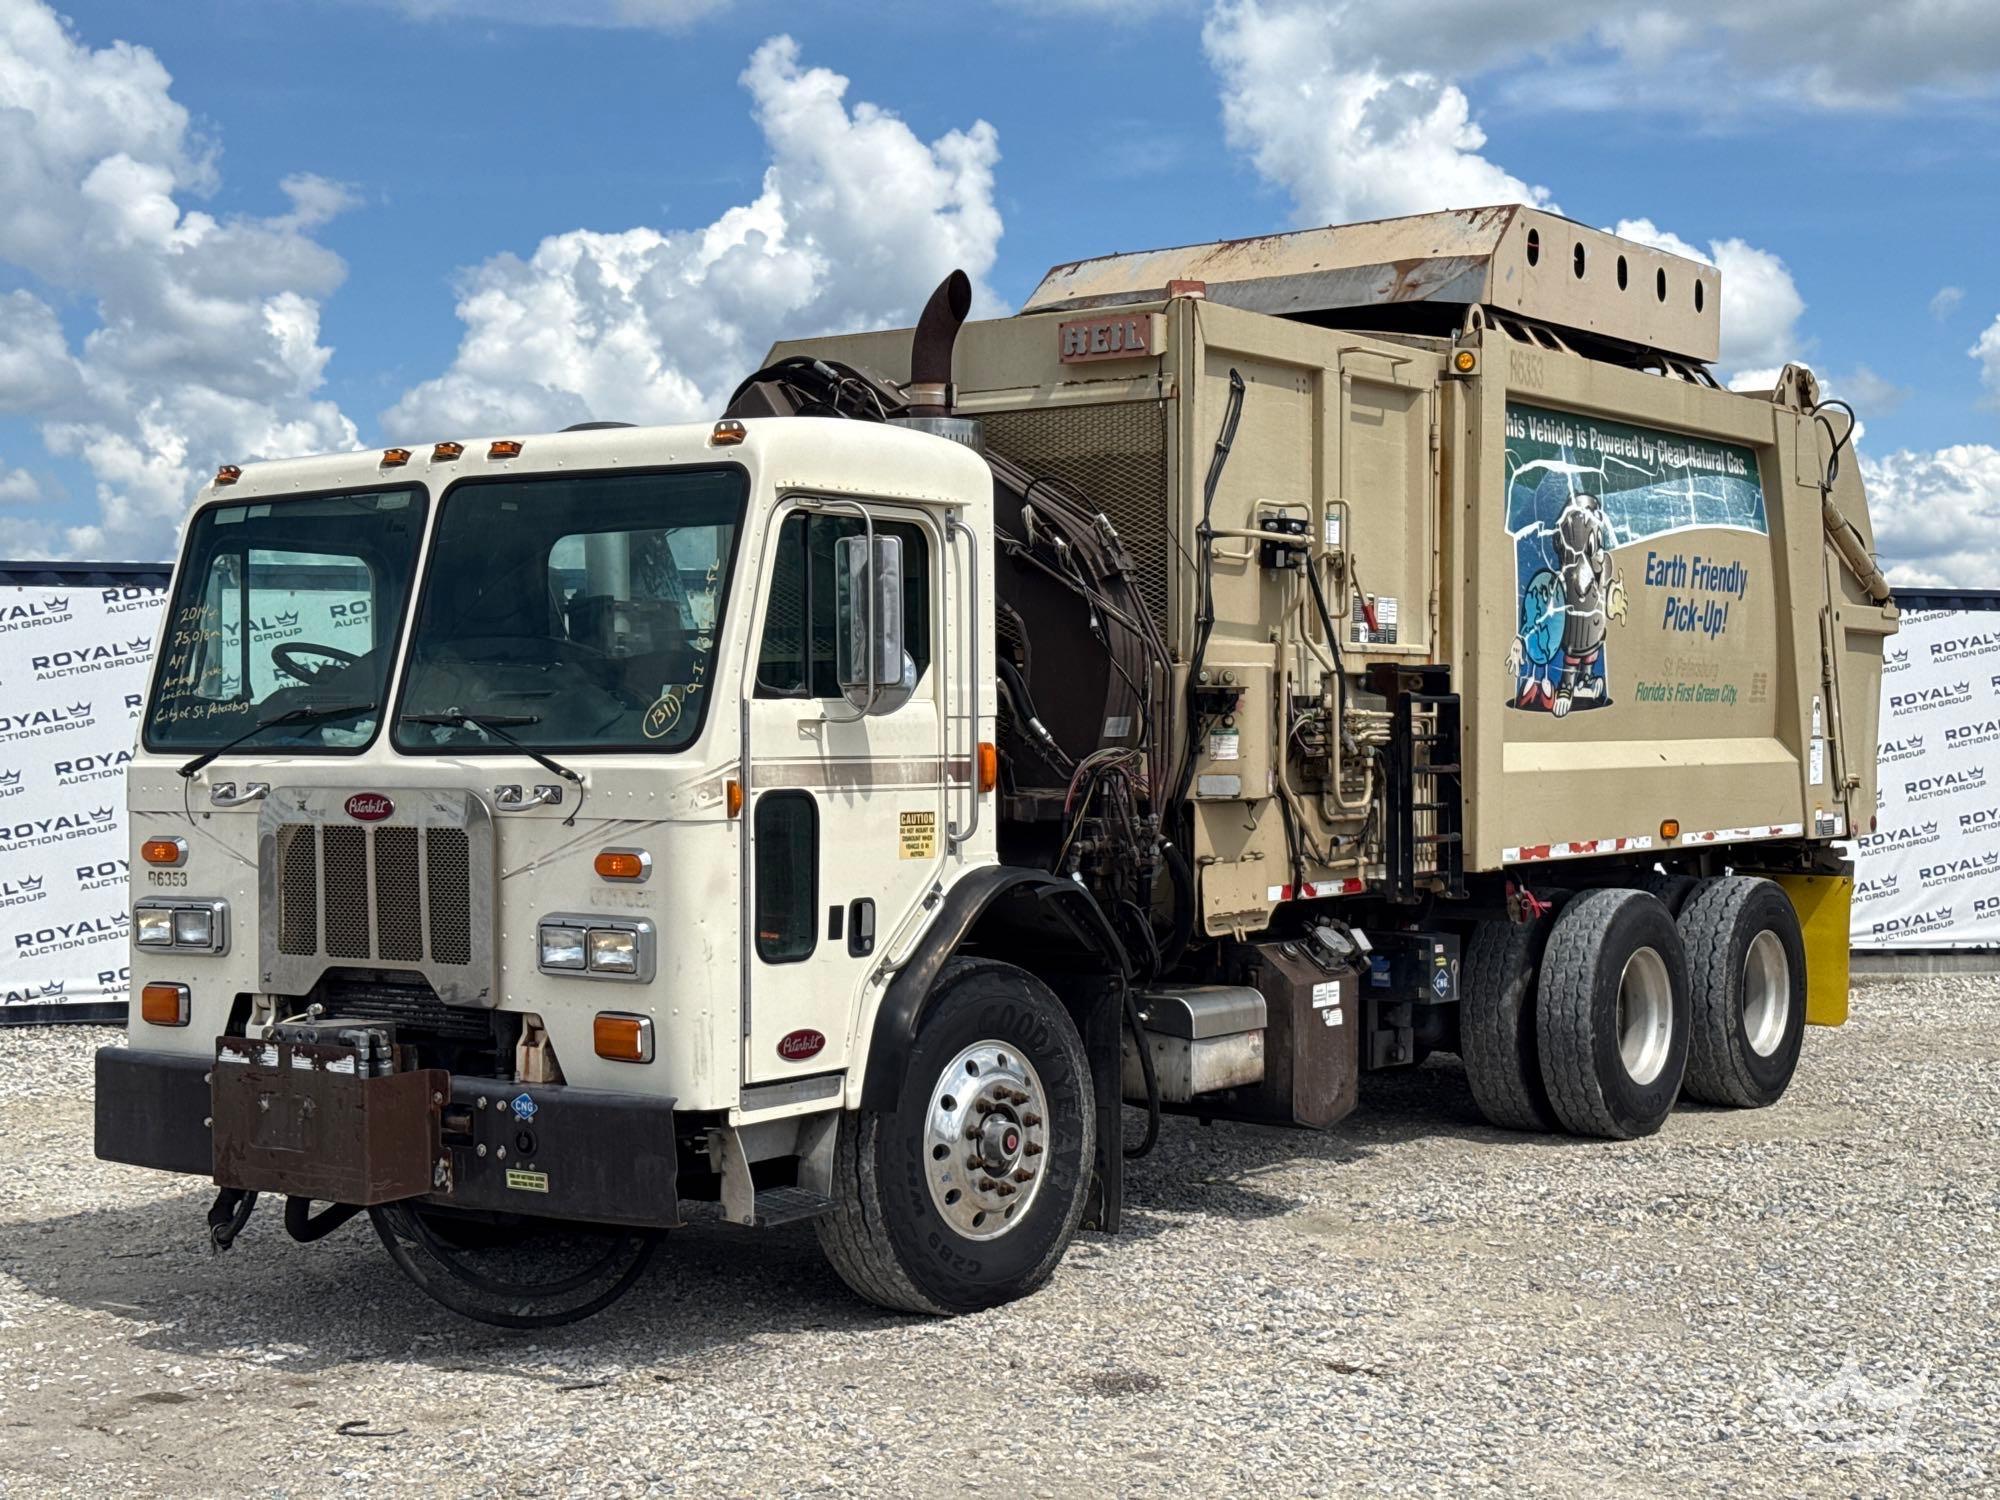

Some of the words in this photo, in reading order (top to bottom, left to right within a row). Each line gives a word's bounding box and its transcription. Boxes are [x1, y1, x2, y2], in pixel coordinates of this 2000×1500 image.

[1063, 321, 1145, 356] HEIL
[1506, 412, 1526, 440] his
[1528, 416, 1574, 448] Vehicle
[1576, 424, 1587, 450] is
[1590, 427, 1639, 459] Powered
[1641, 437, 1654, 466] by
[1657, 439, 1686, 466] Clean
[1688, 445, 1725, 472] Natural
[1726, 453, 1748, 475] Gas.
[1645, 551, 1687, 589] Earth
[1690, 556, 1748, 601] Friendly
[102, 587, 168, 604] ROY
[0, 603, 45, 622] YAL
[21, 613, 73, 629] GROUP
[334, 615, 371, 628] AUCT
[1662, 596, 1729, 640] Pick-Up!
[1899, 616, 1922, 626] TION
[1923, 609, 1958, 622] GROUP
[223, 617, 276, 636] YAL
[253, 627, 302, 643] GROUP
[1930, 633, 1994, 656] ROYAL
[1933, 648, 1976, 664] AUCTION
[1977, 644, 2000, 655] GRO
[32, 643, 128, 670] ROYAL
[36, 660, 103, 681] AUCTION
[1882, 663, 1911, 674] ROUP
[1635, 681, 1673, 703] Florida's
[1675, 682, 1695, 702] First
[1696, 683, 1720, 702] Green
[1721, 684, 1737, 707] City.
[1890, 686, 1954, 708] ROYAL
[1893, 701, 1937, 717] AUCTION
[1938, 694, 1972, 707] GROUP
[0, 708, 68, 732] OYAL
[0, 728, 41, 743] CTION
[44, 718, 96, 735] GROUP
[1945, 719, 2000, 742] ROYA
[1947, 734, 1991, 749] AUCTION
[55, 750, 134, 775] ROYA
[1891, 749, 1926, 761] GROUP
[58, 768, 124, 786] AUCTION
[1905, 771, 1969, 794] ROYAL
[1907, 787, 1951, 802] AUCTION
[1953, 780, 1987, 793] GROUP
[0, 813, 90, 840] ROYAL
[901, 813, 934, 825] CAUTION
[1959, 808, 2000, 827] ROY
[1962, 821, 2000, 835] AUCTIO
[0, 833, 64, 852] AUCTION
[66, 823, 118, 839] GROUP
[1858, 826, 1922, 849] ROYAL
[1861, 843, 1905, 857] AUCTION
[1906, 834, 1940, 848] GROUP
[76, 859, 130, 881] ROY
[148, 871, 188, 887] R6353
[1919, 857, 1983, 880] ROYAL
[1922, 873, 1966, 888] AUCTION
[1967, 864, 2000, 878] GROUP
[80, 875, 130, 891] AUCTI
[1864, 887, 1900, 901] GROUP
[1872, 911, 1937, 934] ROYAL
[1976, 909, 2000, 920] AUCT
[15, 918, 106, 948] ROYAL
[1874, 928, 1918, 943] AUCTION
[1920, 919, 1954, 933] GROUP
[18, 938, 86, 959] AUCTION
[88, 929, 130, 945] GROU
[515, 1100, 533, 1112] CNG
